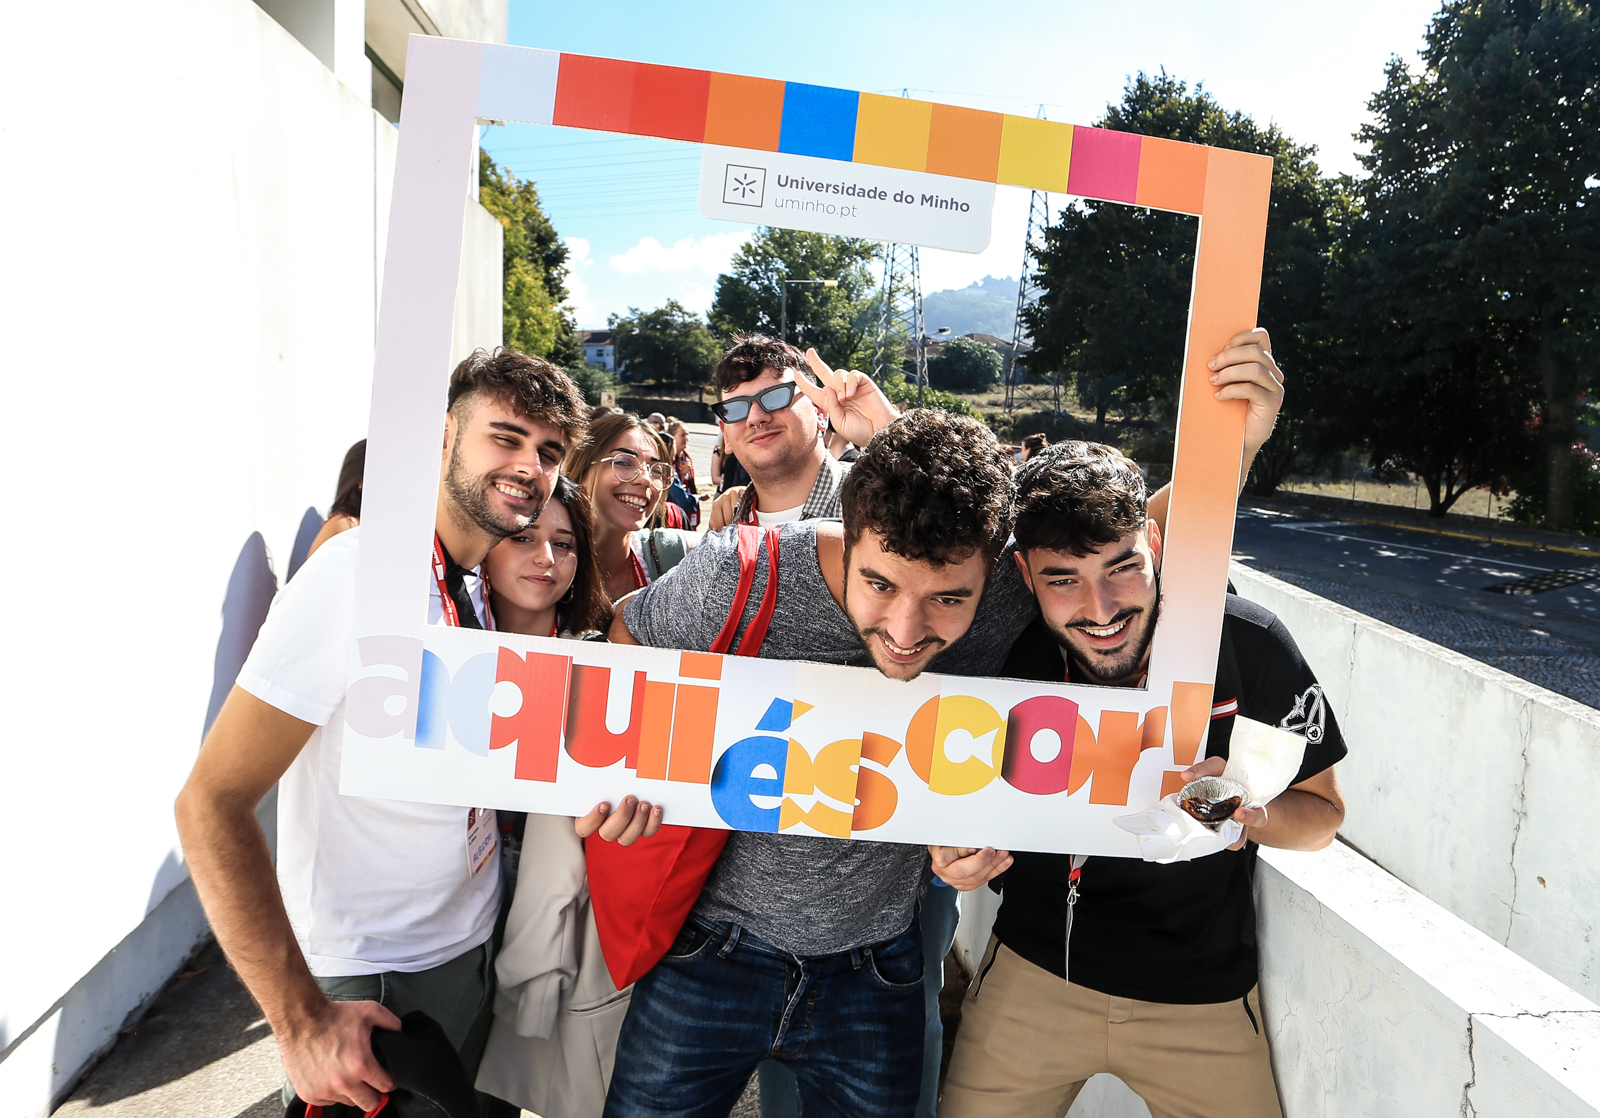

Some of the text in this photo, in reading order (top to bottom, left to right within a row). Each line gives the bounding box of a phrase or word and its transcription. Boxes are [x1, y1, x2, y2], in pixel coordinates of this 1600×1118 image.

[774, 197, 858, 218] uminho.pt
[776, 174, 970, 212] Universidade do Minho
[345, 635, 723, 784] aqui
